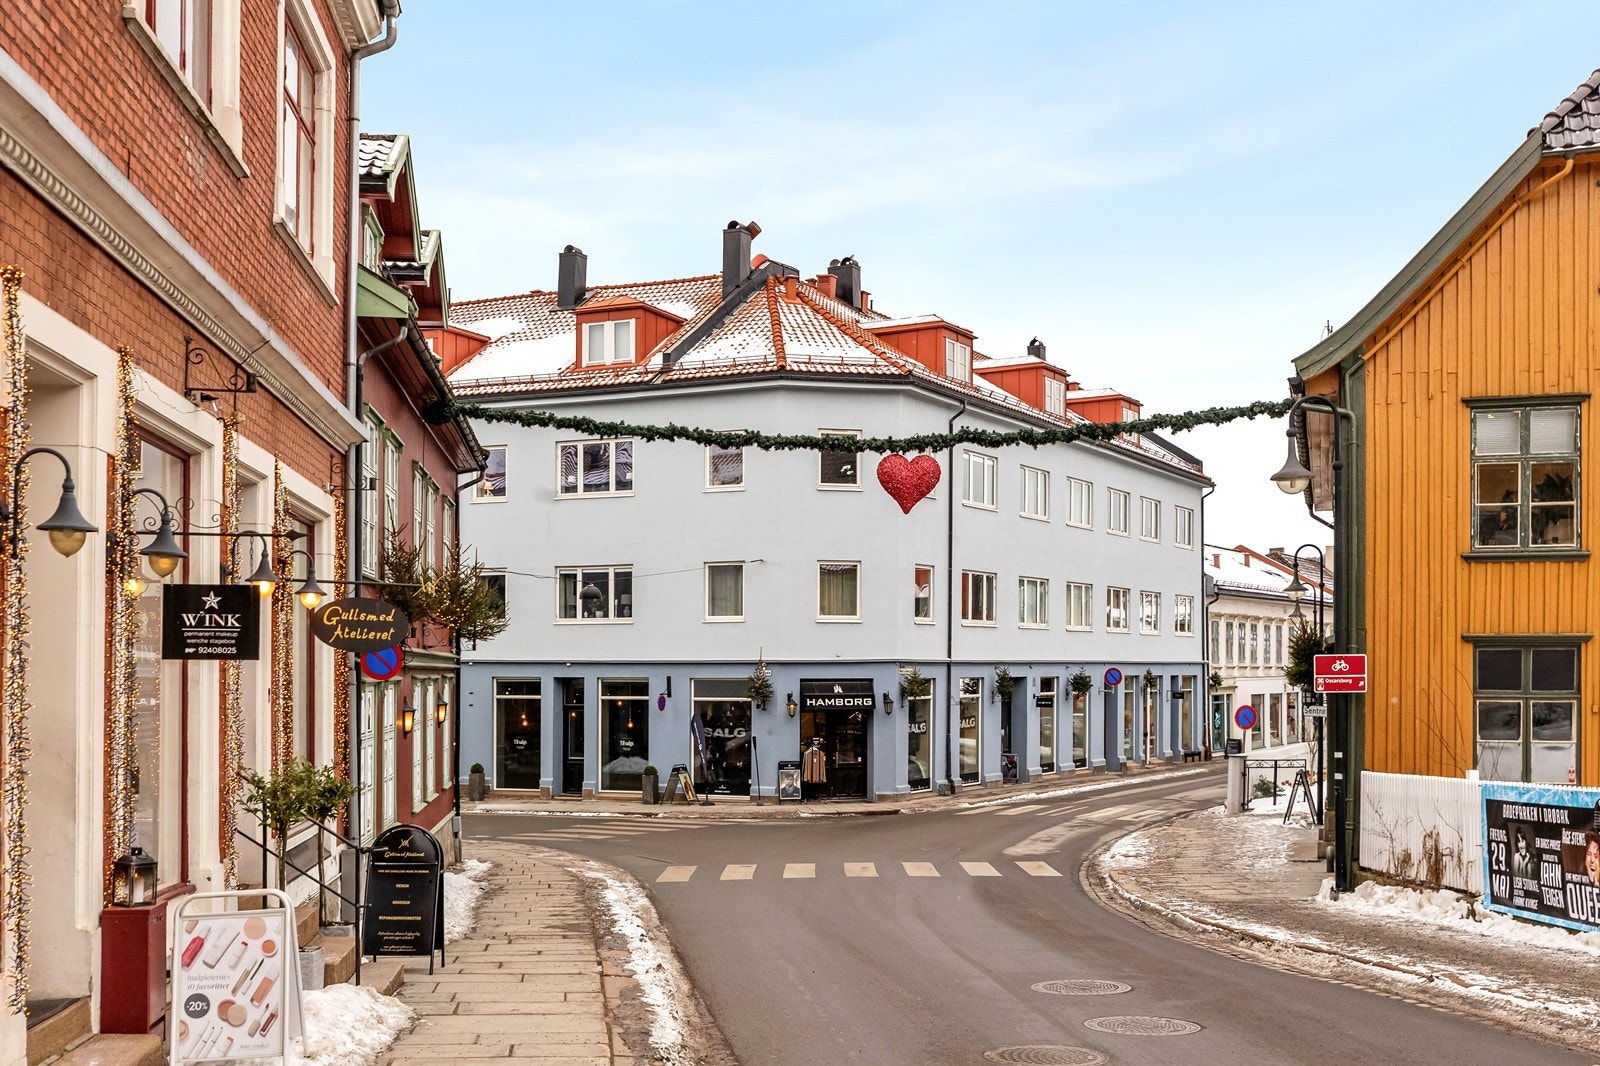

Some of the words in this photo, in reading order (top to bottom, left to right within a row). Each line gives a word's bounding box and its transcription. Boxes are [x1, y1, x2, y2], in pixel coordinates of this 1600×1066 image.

[323, 606, 395, 625] Gullsmed
[329, 624, 395, 643] Atelieret
[807, 698, 872, 706] HAMBORG
[704, 727, 746, 738] SALG
[1489, 828, 1507, 842] FREDAG
[1491, 842, 1509, 872] 29.
[1540, 861, 1562, 888] JAHN
[1492, 874, 1509, 899] MAI
[1541, 886, 1565, 908] TEIGEN
[196, 983, 230, 991] favoritter
[187, 1001, 208, 1011] -20%
